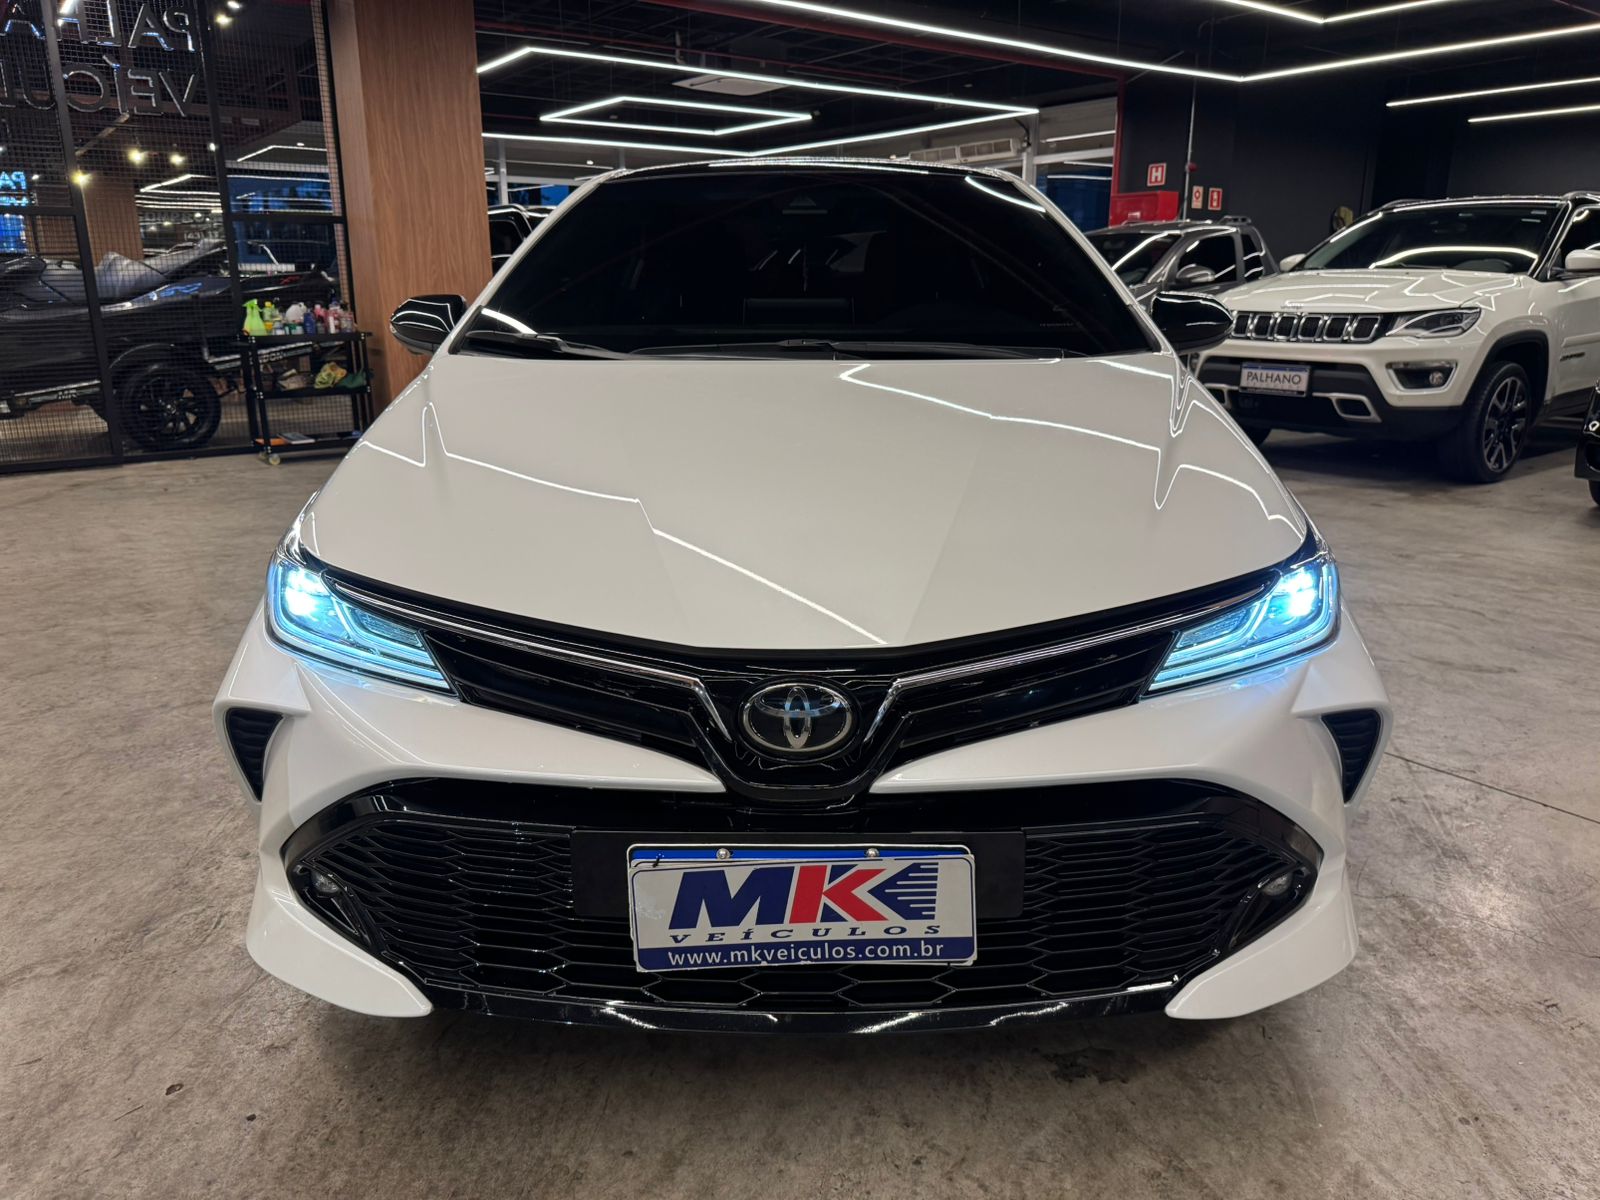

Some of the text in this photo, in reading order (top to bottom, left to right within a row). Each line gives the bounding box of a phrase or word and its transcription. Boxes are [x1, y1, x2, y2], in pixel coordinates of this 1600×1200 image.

[1151, 167, 1162, 183] H
[1246, 371, 1302, 385] PALHANO
[669, 924, 941, 944] VEÍCULOS
[667, 941, 945, 966] www.mkveiculos.com.br
